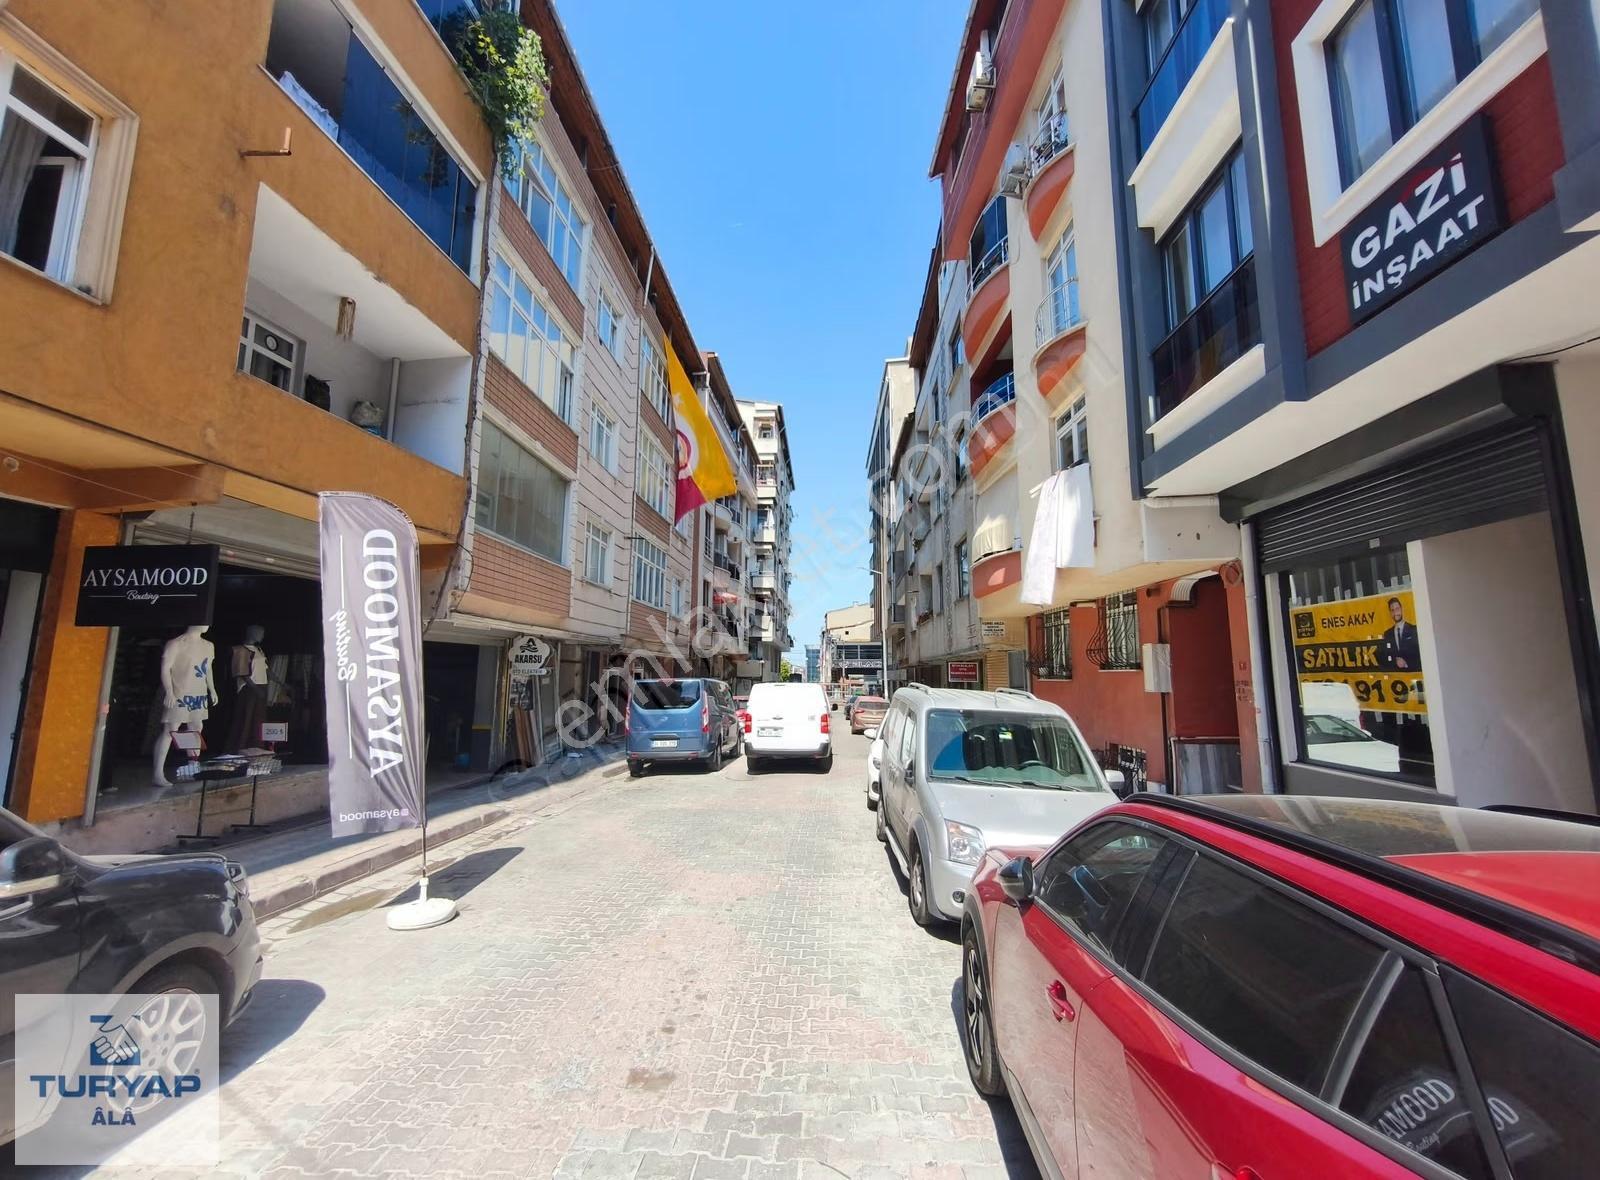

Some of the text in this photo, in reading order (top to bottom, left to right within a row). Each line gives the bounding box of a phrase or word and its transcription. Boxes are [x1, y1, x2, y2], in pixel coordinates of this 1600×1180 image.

[1351, 152, 1467, 269] GAZİ
[1352, 194, 1485, 309] İNŞAAT
[83, 567, 208, 587] AYSAMOOD
[1321, 611, 1376, 629] ENES AKAY
[514, 654, 543, 664] AKARSU
[1302, 644, 1380, 669] SATILIK
